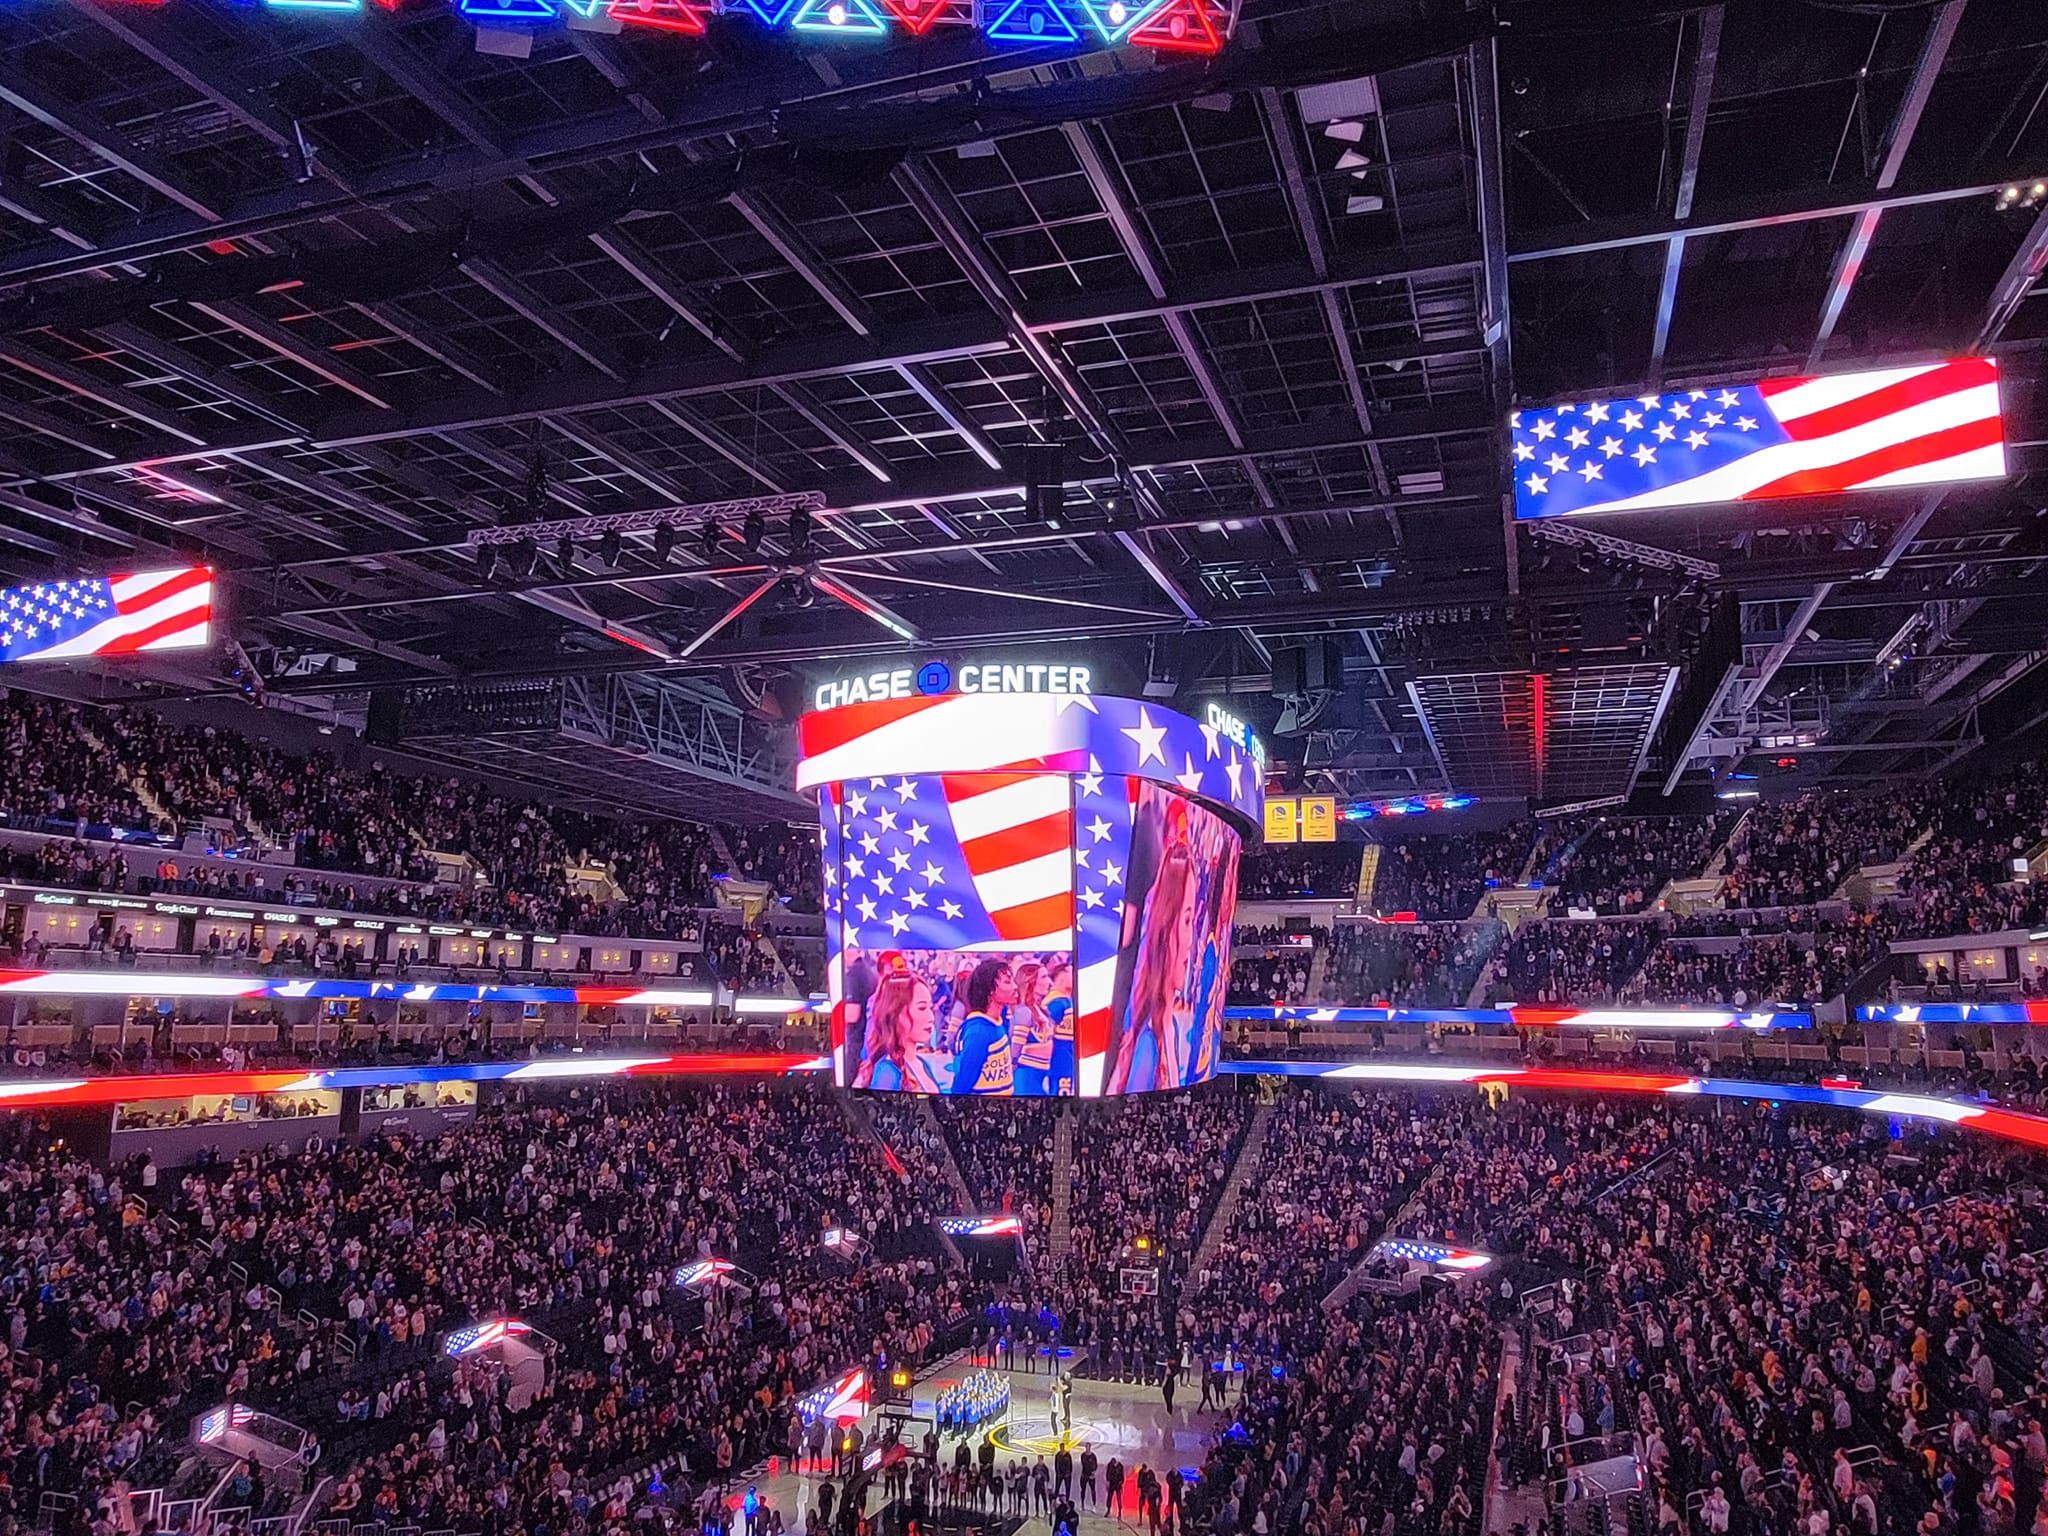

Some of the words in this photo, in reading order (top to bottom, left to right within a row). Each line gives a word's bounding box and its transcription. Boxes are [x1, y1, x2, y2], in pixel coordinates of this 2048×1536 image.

[815, 669, 913, 712] CHASE
[958, 664, 1092, 694] CENTER
[1207, 703, 1246, 748] CHASE
